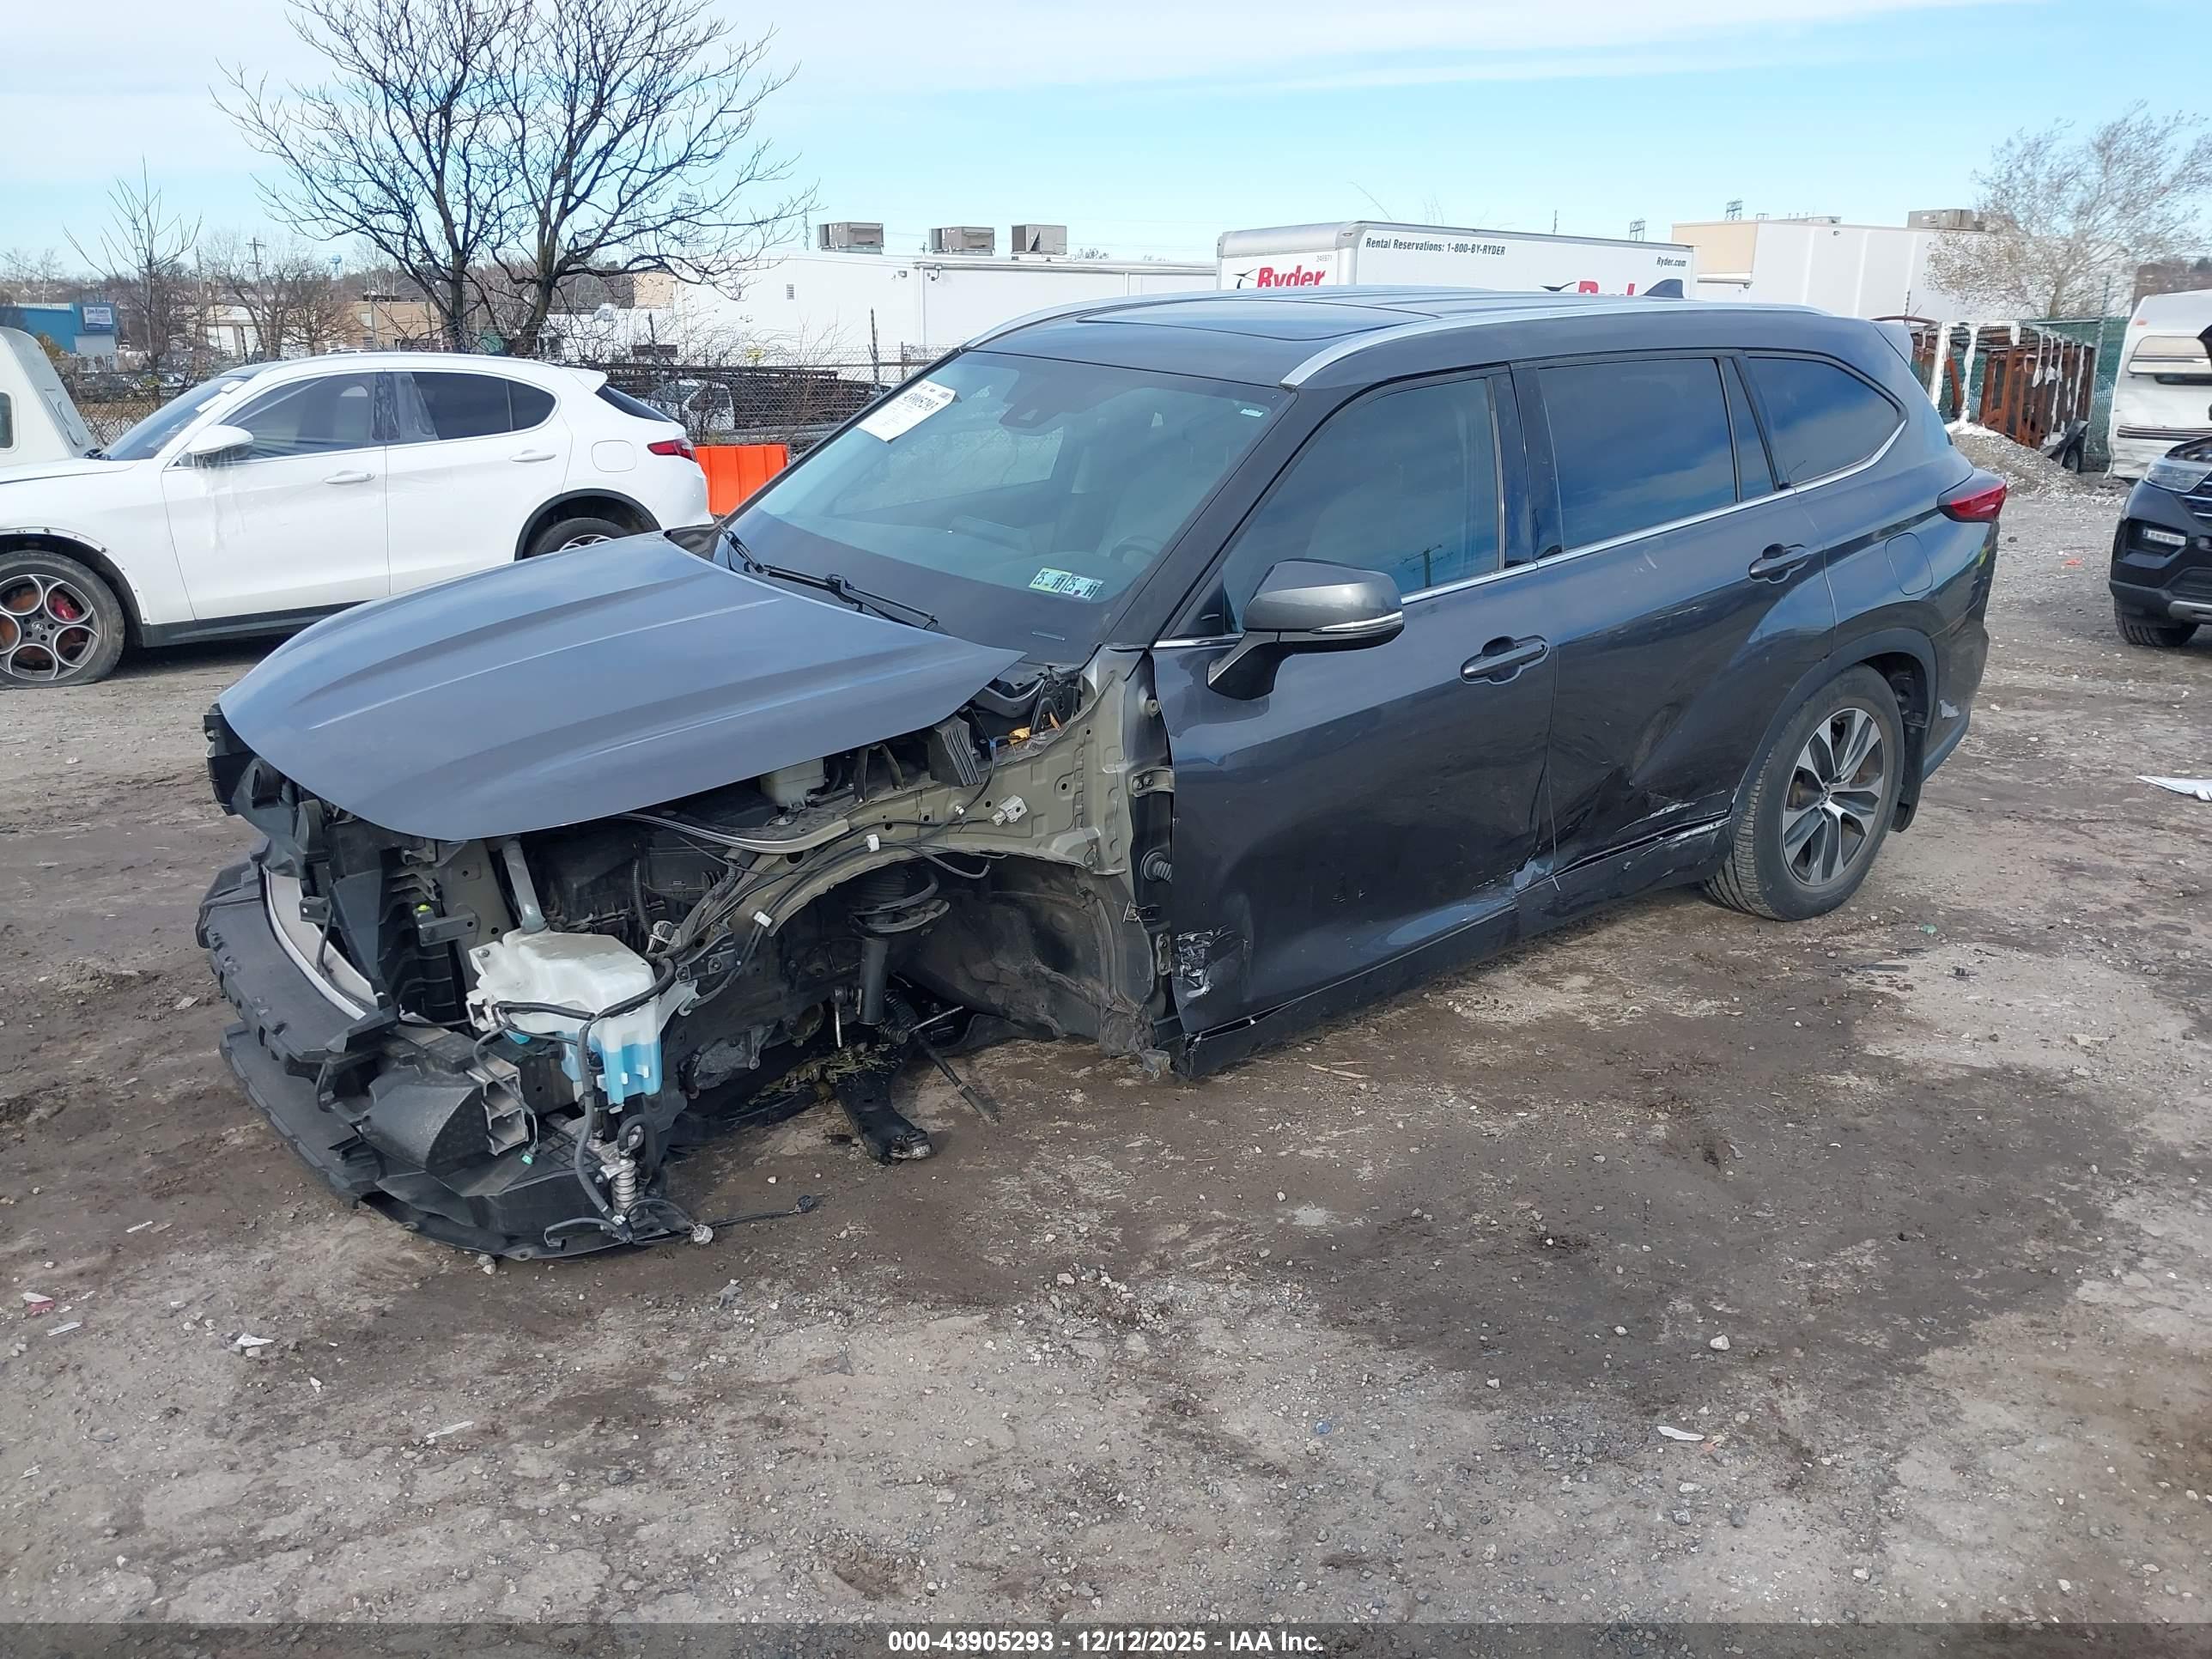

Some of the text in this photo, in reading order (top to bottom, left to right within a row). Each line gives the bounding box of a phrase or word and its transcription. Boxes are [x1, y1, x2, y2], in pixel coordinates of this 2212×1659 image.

[1365, 238, 1506, 256] Rental Reservations: 1-800-BY-RYDER
[1656, 257, 1686, 268] Ryder.com
[1257, 264, 1326, 288] Ryder
